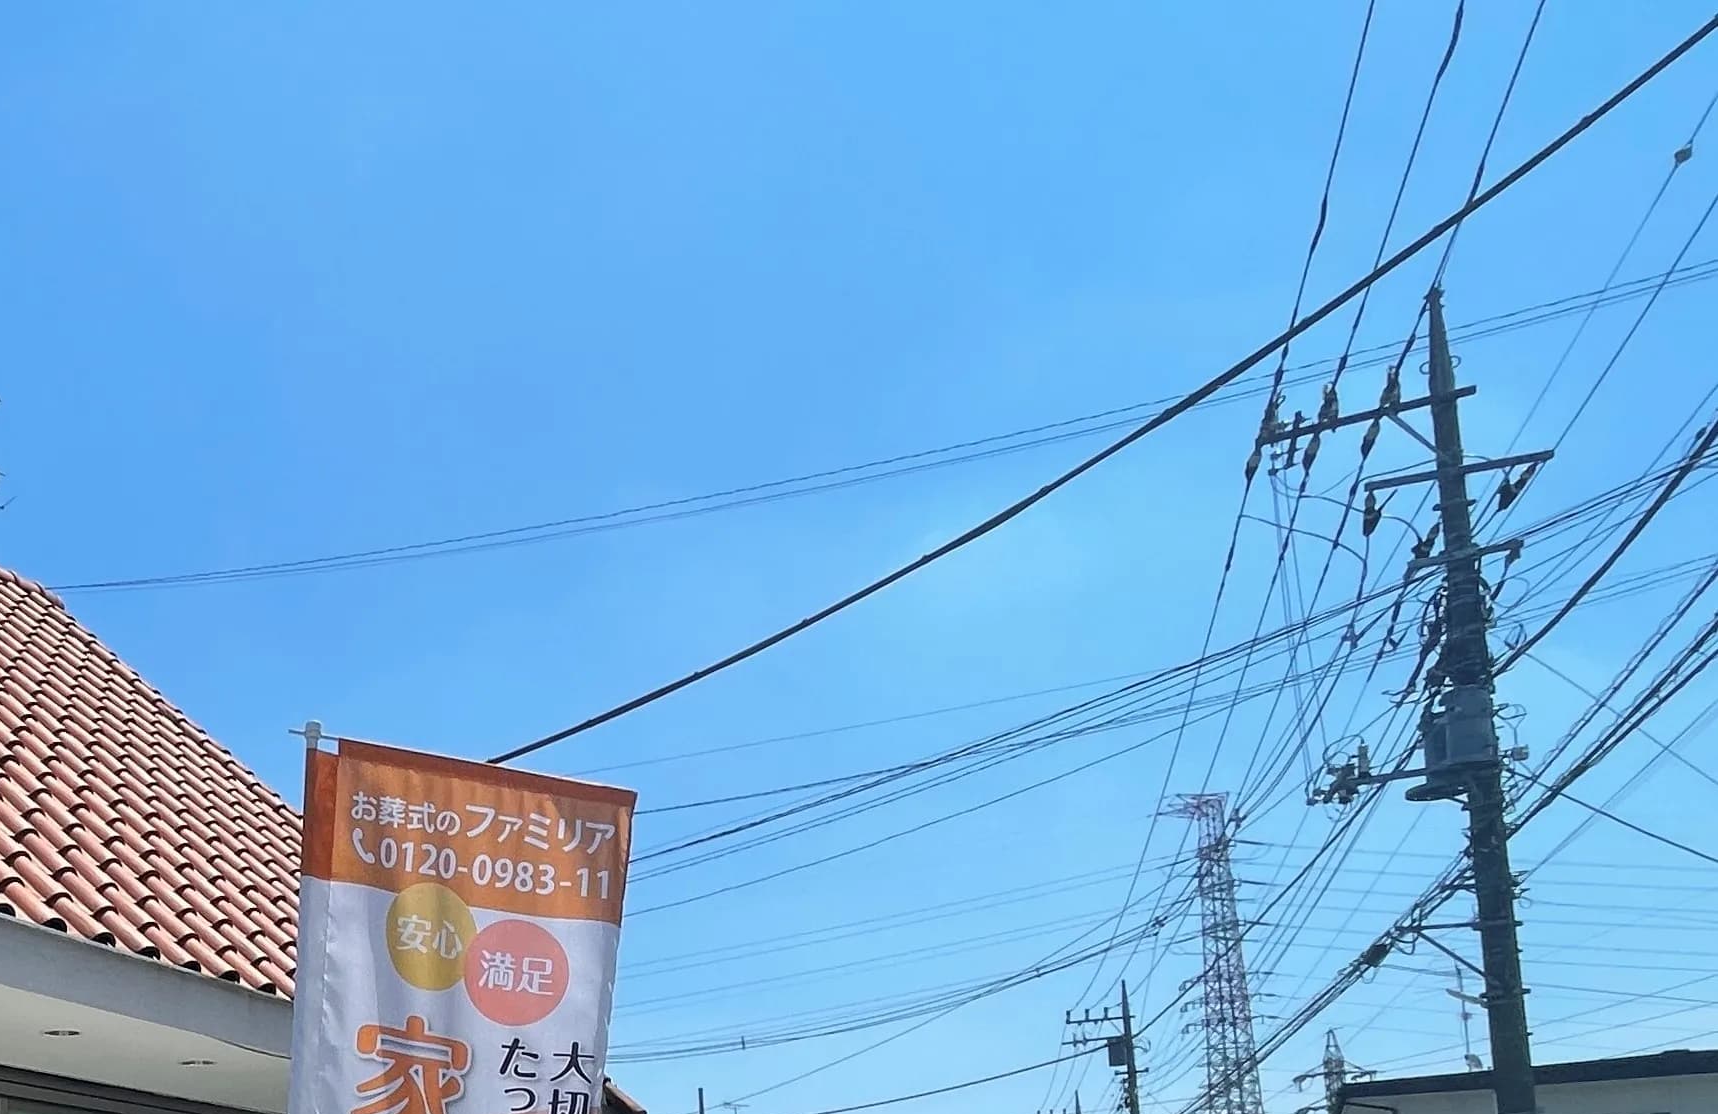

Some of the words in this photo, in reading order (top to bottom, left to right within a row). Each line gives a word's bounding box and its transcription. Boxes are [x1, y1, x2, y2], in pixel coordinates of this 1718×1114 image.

[350, 790, 616, 855] お葬式のファミリア
[380, 837, 610, 900] 0120-0983-11
[395, 914, 463, 960] 安心
[478, 949, 555, 997] 満足
